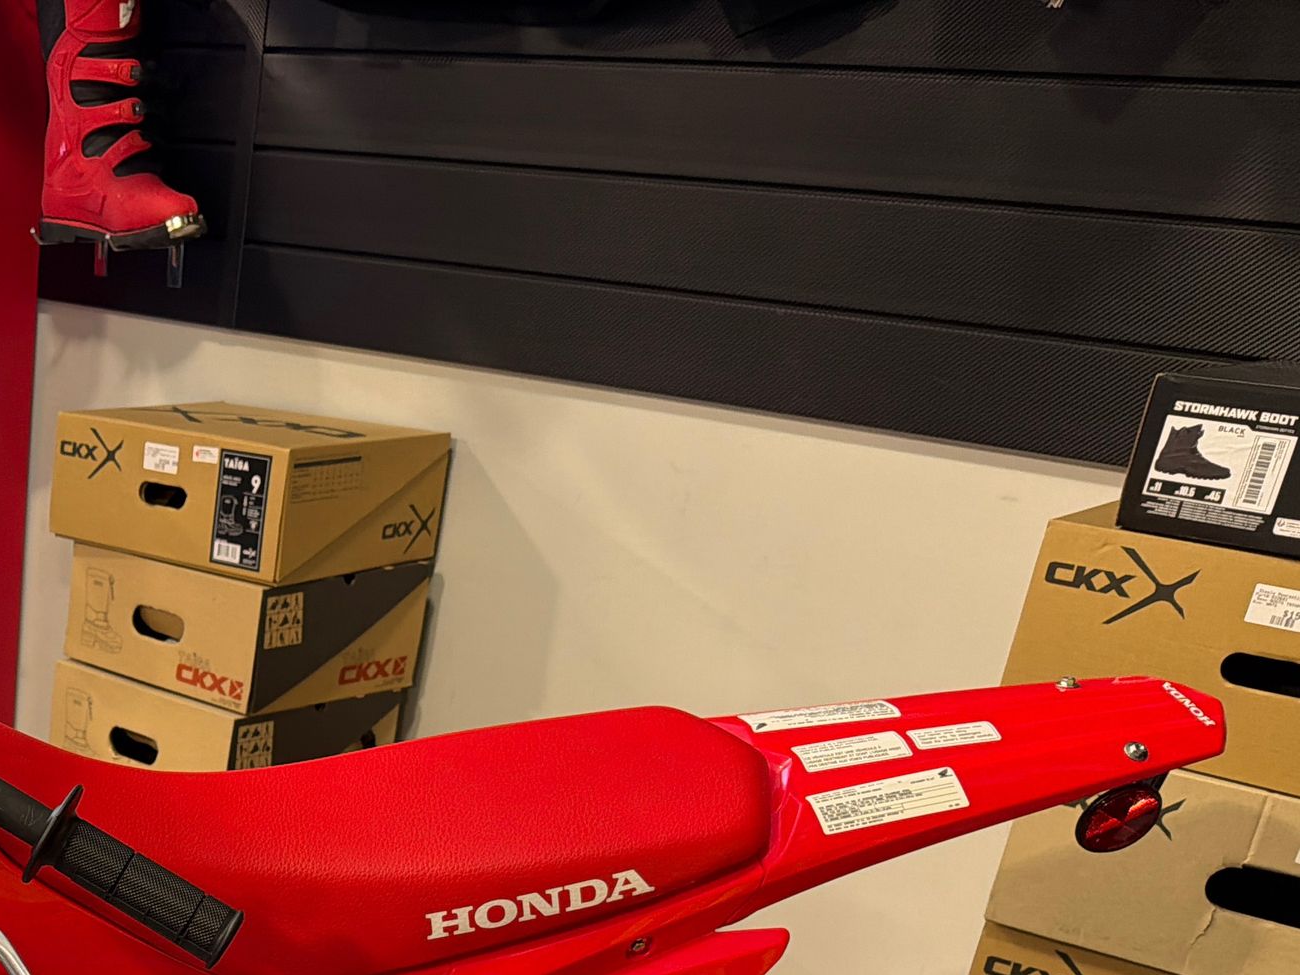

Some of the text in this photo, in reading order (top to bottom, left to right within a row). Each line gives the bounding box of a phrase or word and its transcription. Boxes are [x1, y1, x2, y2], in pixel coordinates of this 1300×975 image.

[1173, 400, 1300, 427] STORMHAWK BOOT
[1218, 425, 1247, 436] BLACK
[59, 440, 98, 461] CKX
[251, 474, 262, 494] 9
[381, 520, 415, 540] CKX
[1045, 561, 1137, 598] CKX
[175, 663, 229, 694] CKX
[338, 659, 395, 687] CKX
[1162, 681, 1216, 726] HONDA
[425, 869, 656, 940] HONDA
